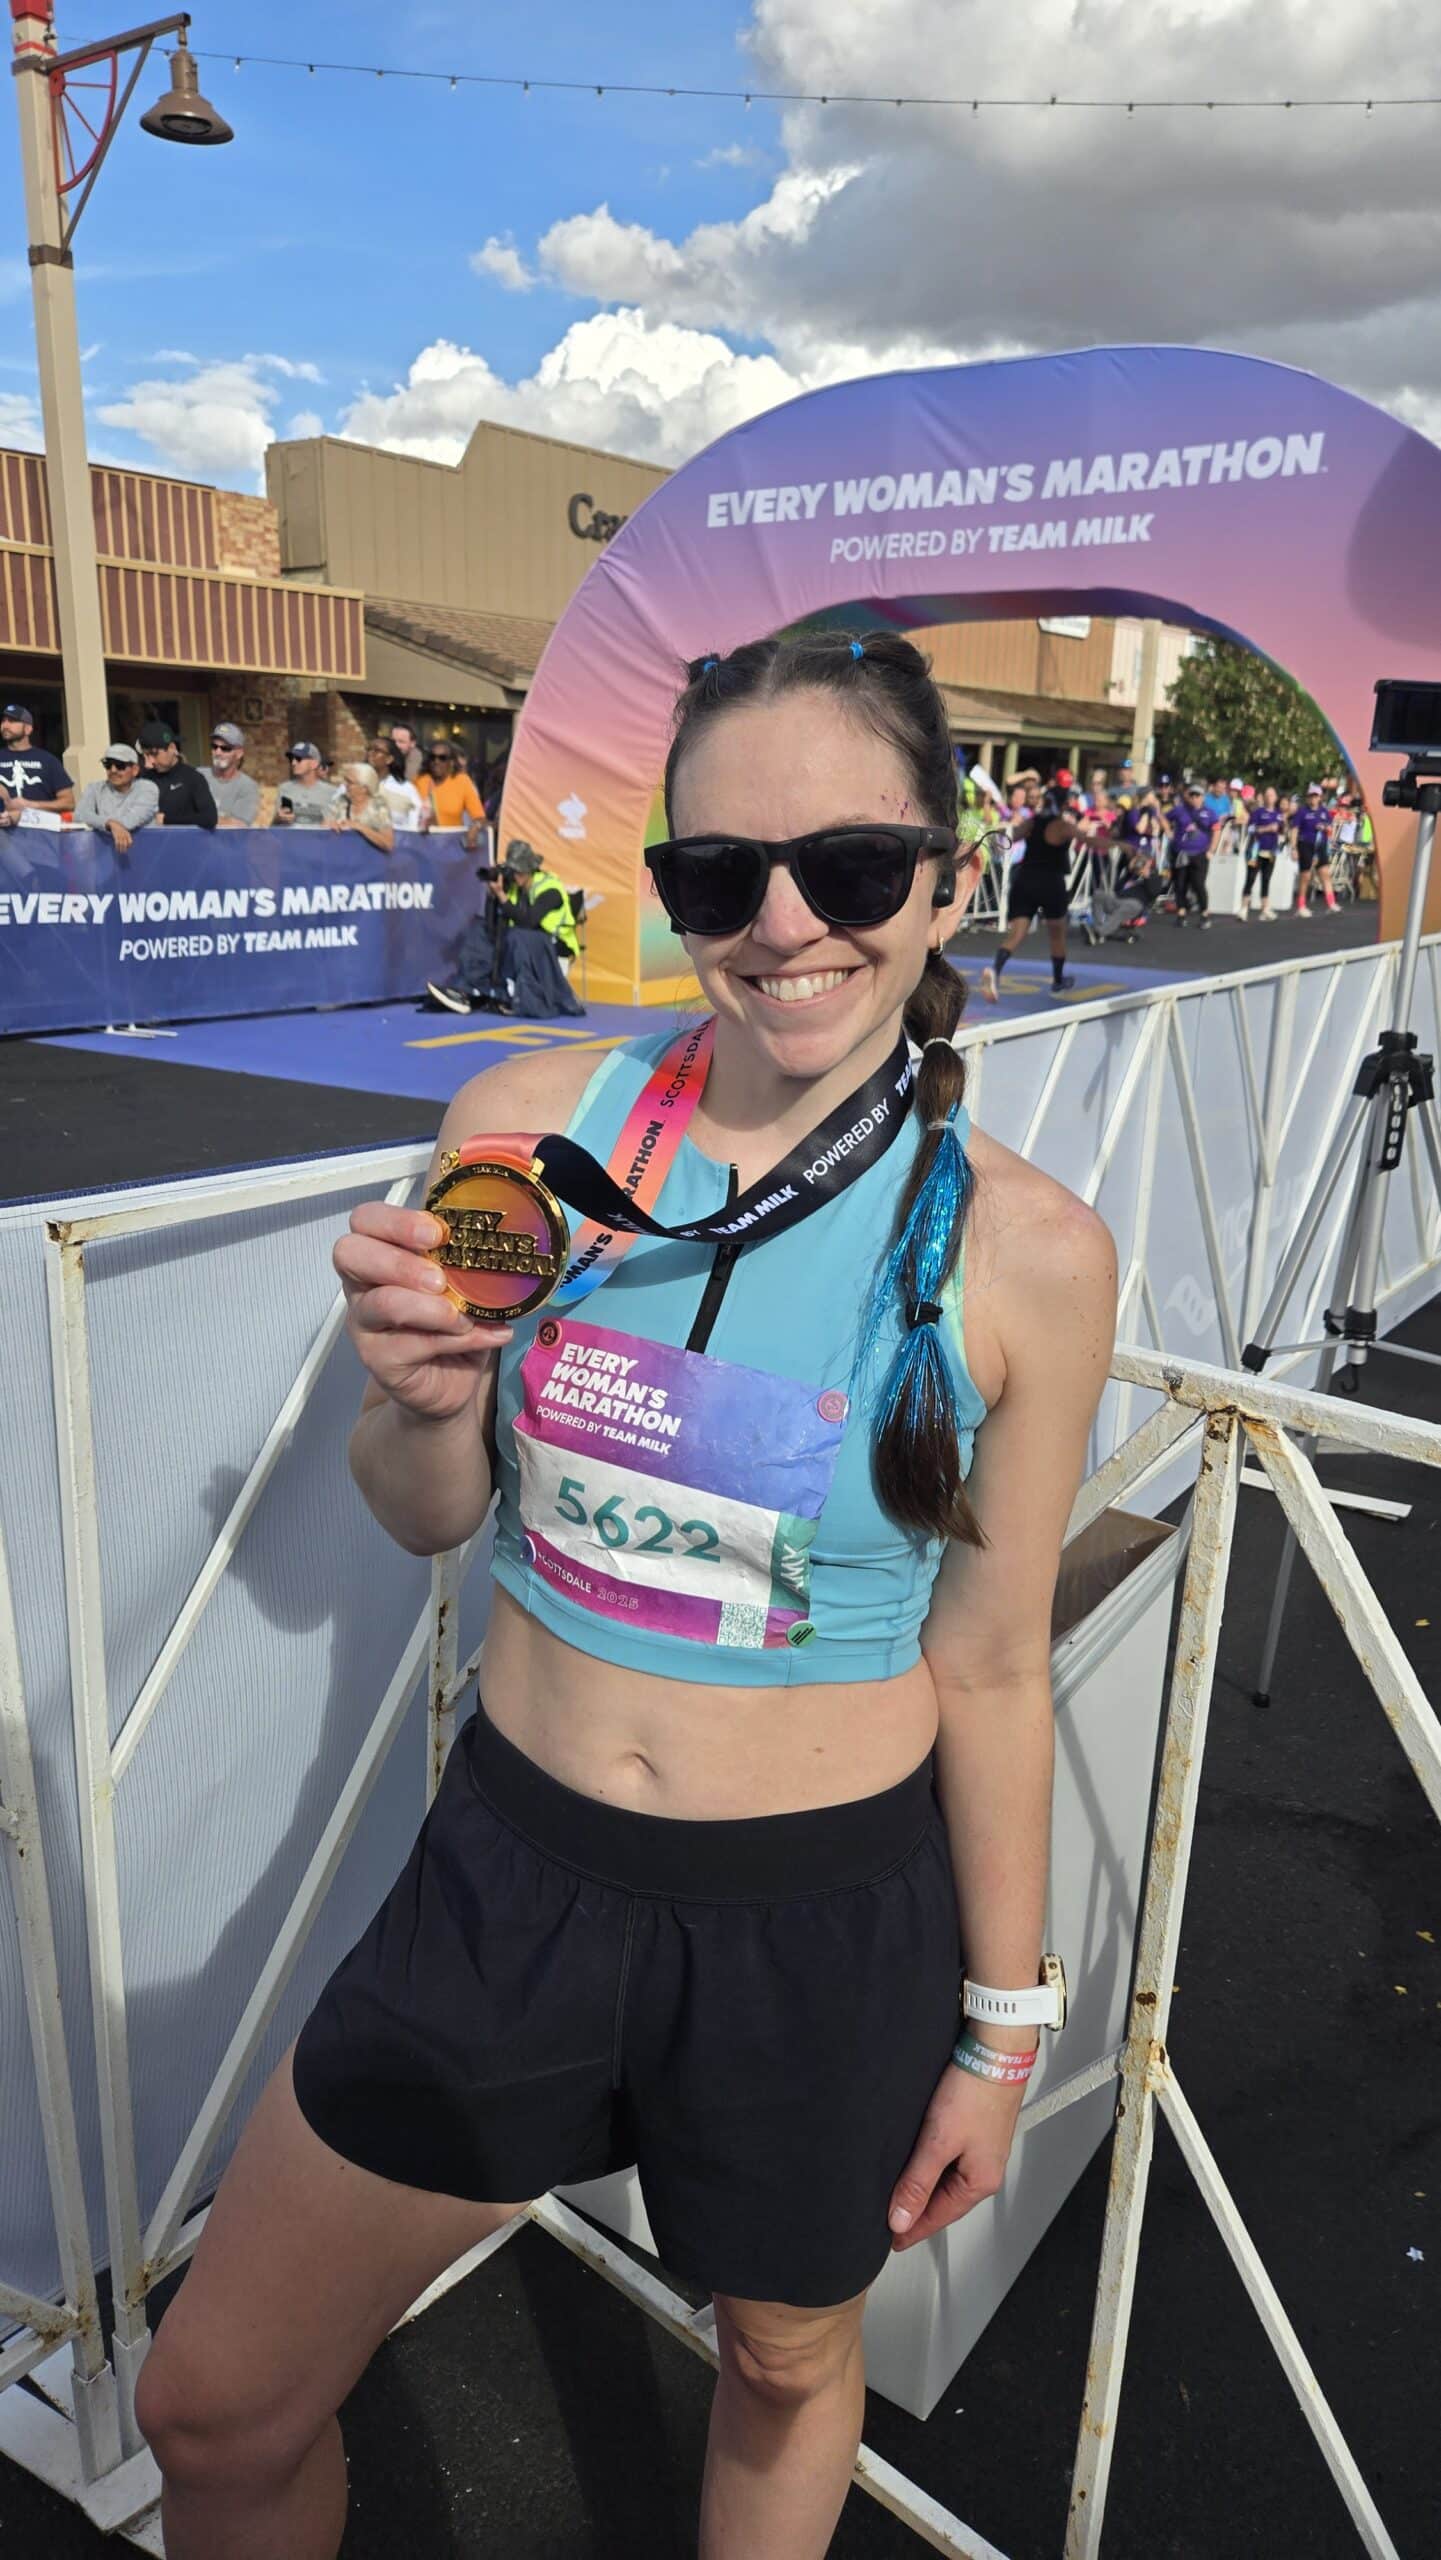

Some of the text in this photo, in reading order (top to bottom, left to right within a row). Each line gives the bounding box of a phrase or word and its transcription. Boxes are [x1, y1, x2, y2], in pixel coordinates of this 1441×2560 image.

[707, 432, 1325, 528] EVERY WOMAN'S MARATHON
[830, 513, 1154, 562] POWERED BY TEAM MILK
[118, 888, 277, 924] WOMAN'S
[282, 882, 434, 916] MARATHON
[119, 925, 358, 961] POWERED BY TEAM MILK
[623, 1120, 665, 1200] RATHON
[803, 1117, 874, 1185] POWERED
[872, 1098, 890, 1125] BY
[709, 1212, 759, 1236] TEAM
[755, 1184, 799, 1217] MILK
[448, 1228, 535, 1256] OMAN'S
[560, 1233, 613, 1288] OMAN'S
[561, 1342, 639, 1376] EVERY
[540, 1380, 681, 1437] MARATHON
[551, 1361, 668, 1409] WOMAN'S
[536, 1405, 672, 1455] POWERED BY TEAM MILK
[555, 1476, 721, 1563] 5622
[597, 1587, 639, 1609] 2025
